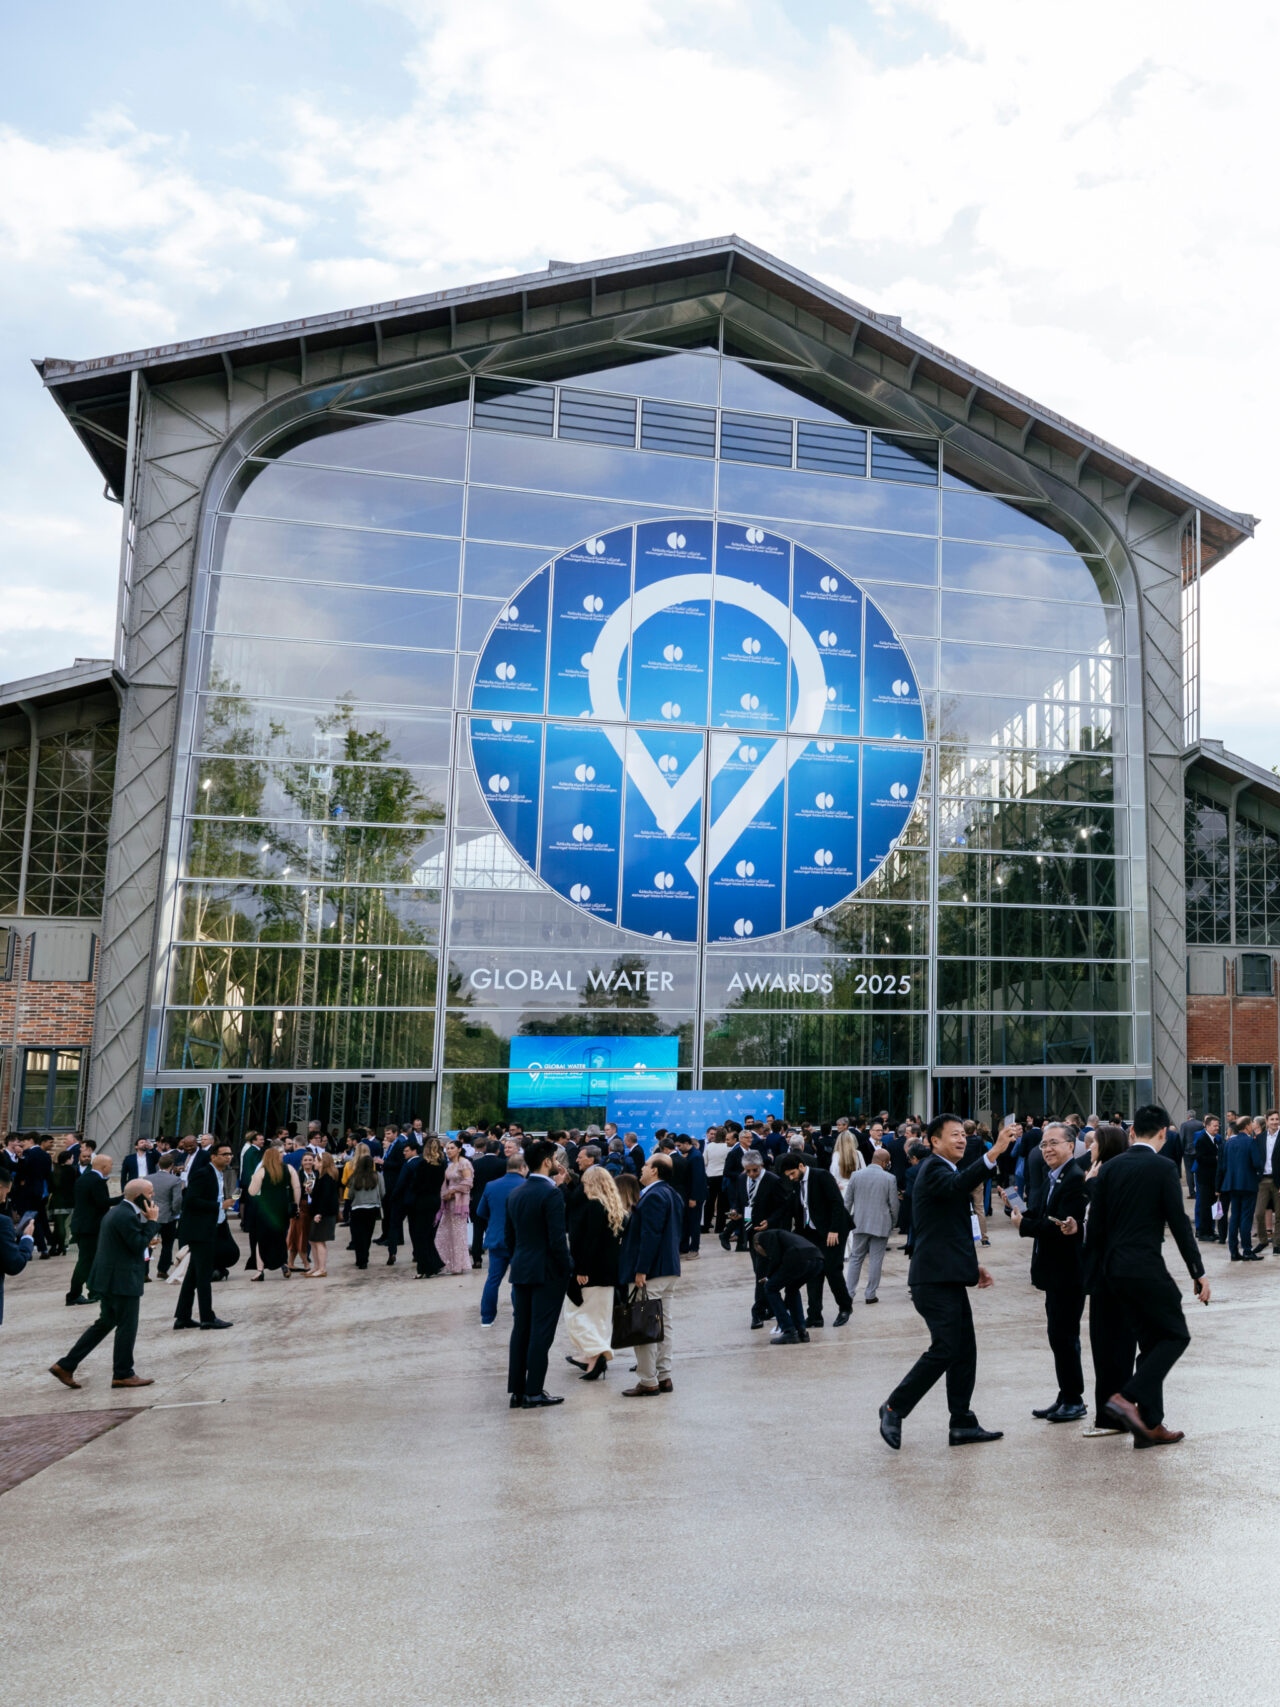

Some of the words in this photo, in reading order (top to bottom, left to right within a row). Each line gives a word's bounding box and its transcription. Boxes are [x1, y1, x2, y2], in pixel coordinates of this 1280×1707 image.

[470, 968, 577, 991] GLOBAL
[587, 969, 674, 992] WATER
[726, 971, 833, 994] AWARDS
[854, 974, 911, 995] 2025
